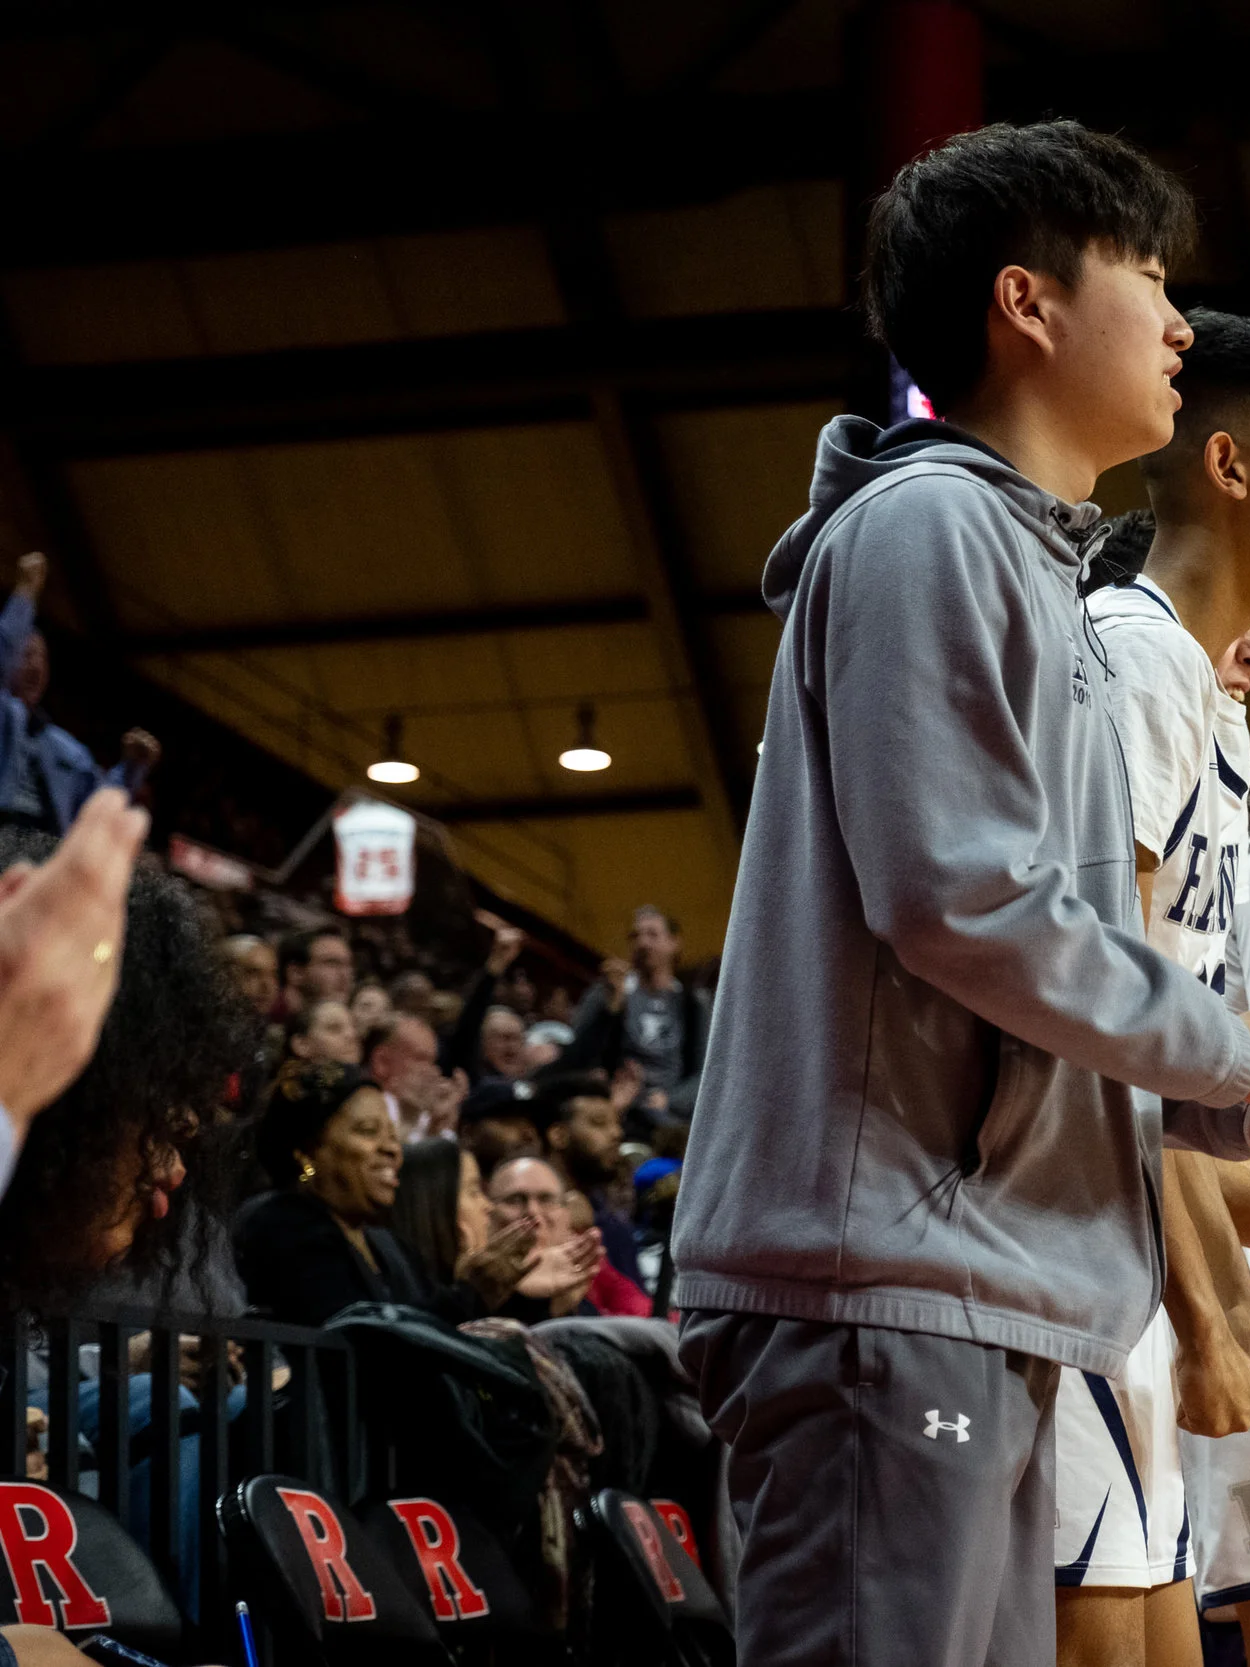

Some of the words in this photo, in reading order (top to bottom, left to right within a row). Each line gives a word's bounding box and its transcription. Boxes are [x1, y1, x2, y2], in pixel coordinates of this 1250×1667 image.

[0, 1483, 111, 1629] R
[277, 1486, 377, 1622] R
[388, 1498, 489, 1621] R
